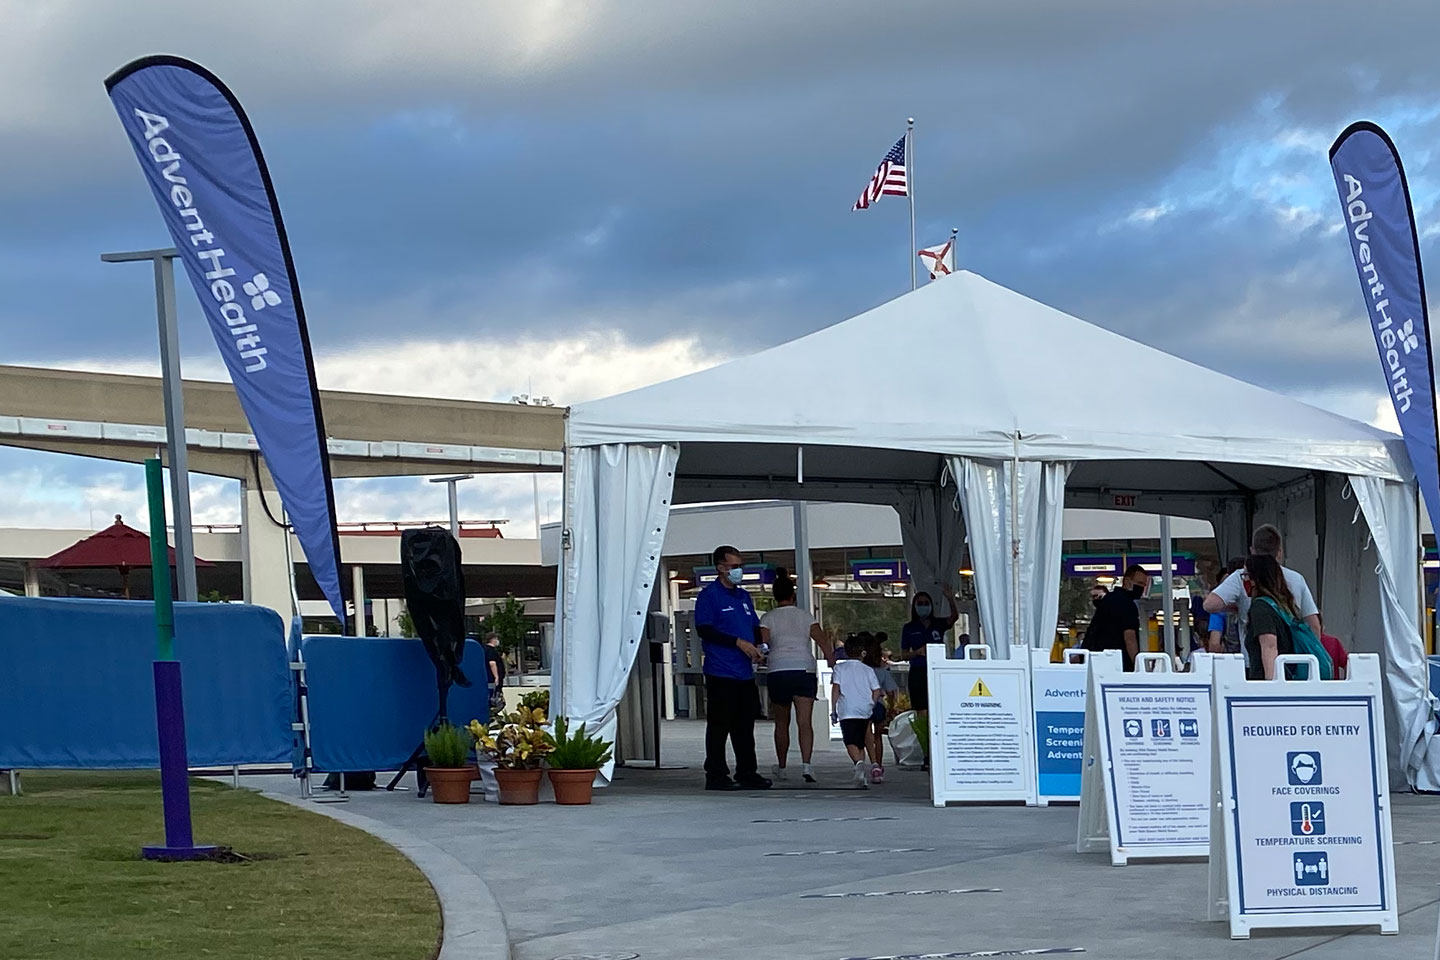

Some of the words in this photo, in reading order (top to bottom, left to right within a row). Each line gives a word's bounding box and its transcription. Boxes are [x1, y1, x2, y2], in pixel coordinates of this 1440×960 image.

[1115, 496, 1136, 506] EXIT
[1044, 689, 1086, 697] AdventH
[1048, 726, 1084, 735] Temper
[1242, 725, 1297, 736] REQUIRED
[1300, 725, 1322, 736] FOR
[1325, 725, 1360, 736] ENTRY
[1271, 786, 1292, 795] FACE
[1294, 786, 1340, 795] COVERINGS
[1254, 837, 1315, 846] TEMPERATURE
[1317, 836, 1362, 845] SCREENING
[1266, 888, 1307, 896] PHYSICAL
[1309, 886, 1358, 896] DISTANCING
